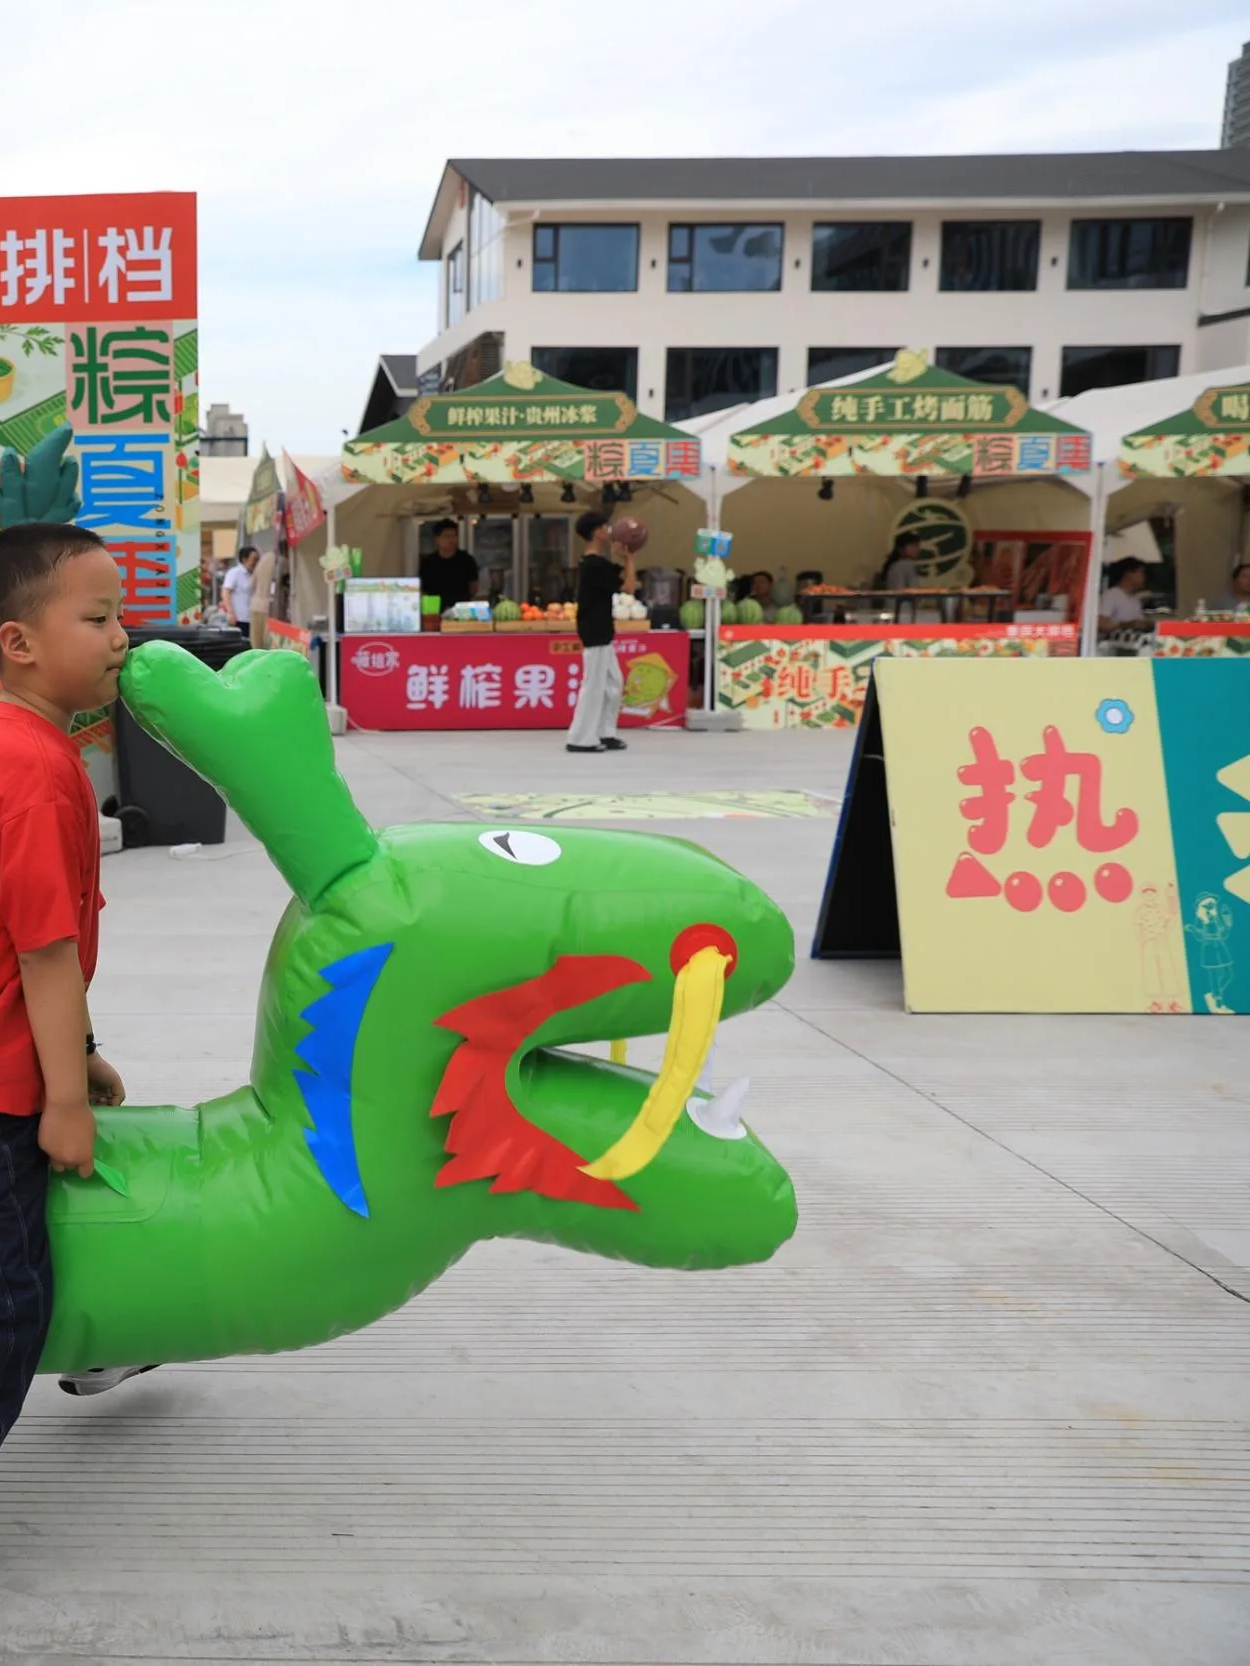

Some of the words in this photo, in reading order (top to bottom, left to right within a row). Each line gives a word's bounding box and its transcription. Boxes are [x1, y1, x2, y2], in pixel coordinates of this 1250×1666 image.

[830, 394, 994, 422] 纯手工烤面筋
